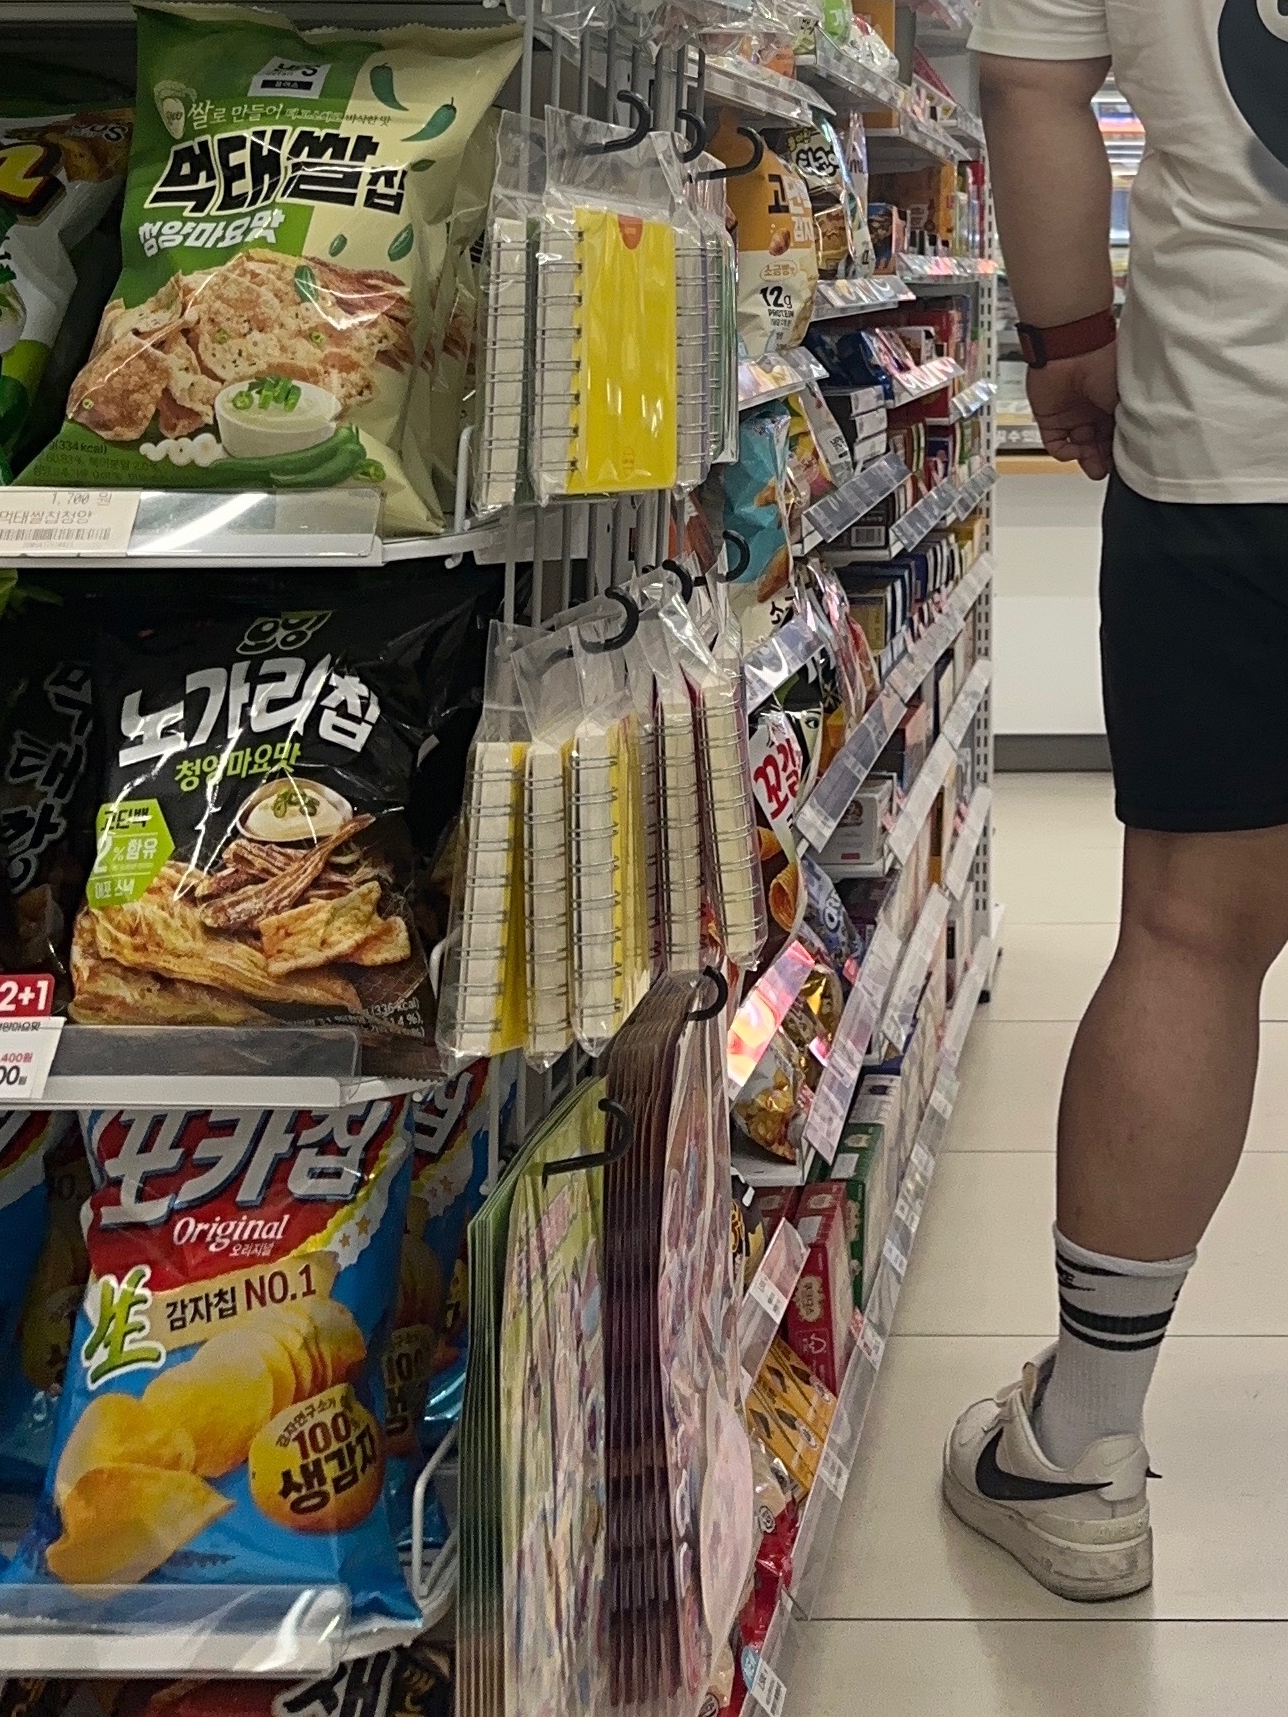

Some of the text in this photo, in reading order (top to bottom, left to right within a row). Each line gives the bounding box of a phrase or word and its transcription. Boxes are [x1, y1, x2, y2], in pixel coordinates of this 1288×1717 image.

[187, 99, 228, 131] 쌀로
[231, 102, 284, 122] 만들어
[143, 125, 408, 217] 먹태쌀칩
[138, 207, 286, 259] 청양마요맛
[760, 285, 793, 310] 12g
[117, 653, 382, 767] 노가리칩
[174, 742, 302, 791] 청양마요맛
[126, 837, 159, 860] 함유
[0, 979, 50, 1012] 2+1
[94, 1107, 393, 1231] 포카칩
[172, 1214, 291, 1253] Original
[228, 1240, 275, 1258] 오리지널
[165, 1263, 317, 1333] 감자칩 NO.1
[82, 1266, 164, 1386] 生
[278, 1422, 378, 1515] 생감자
